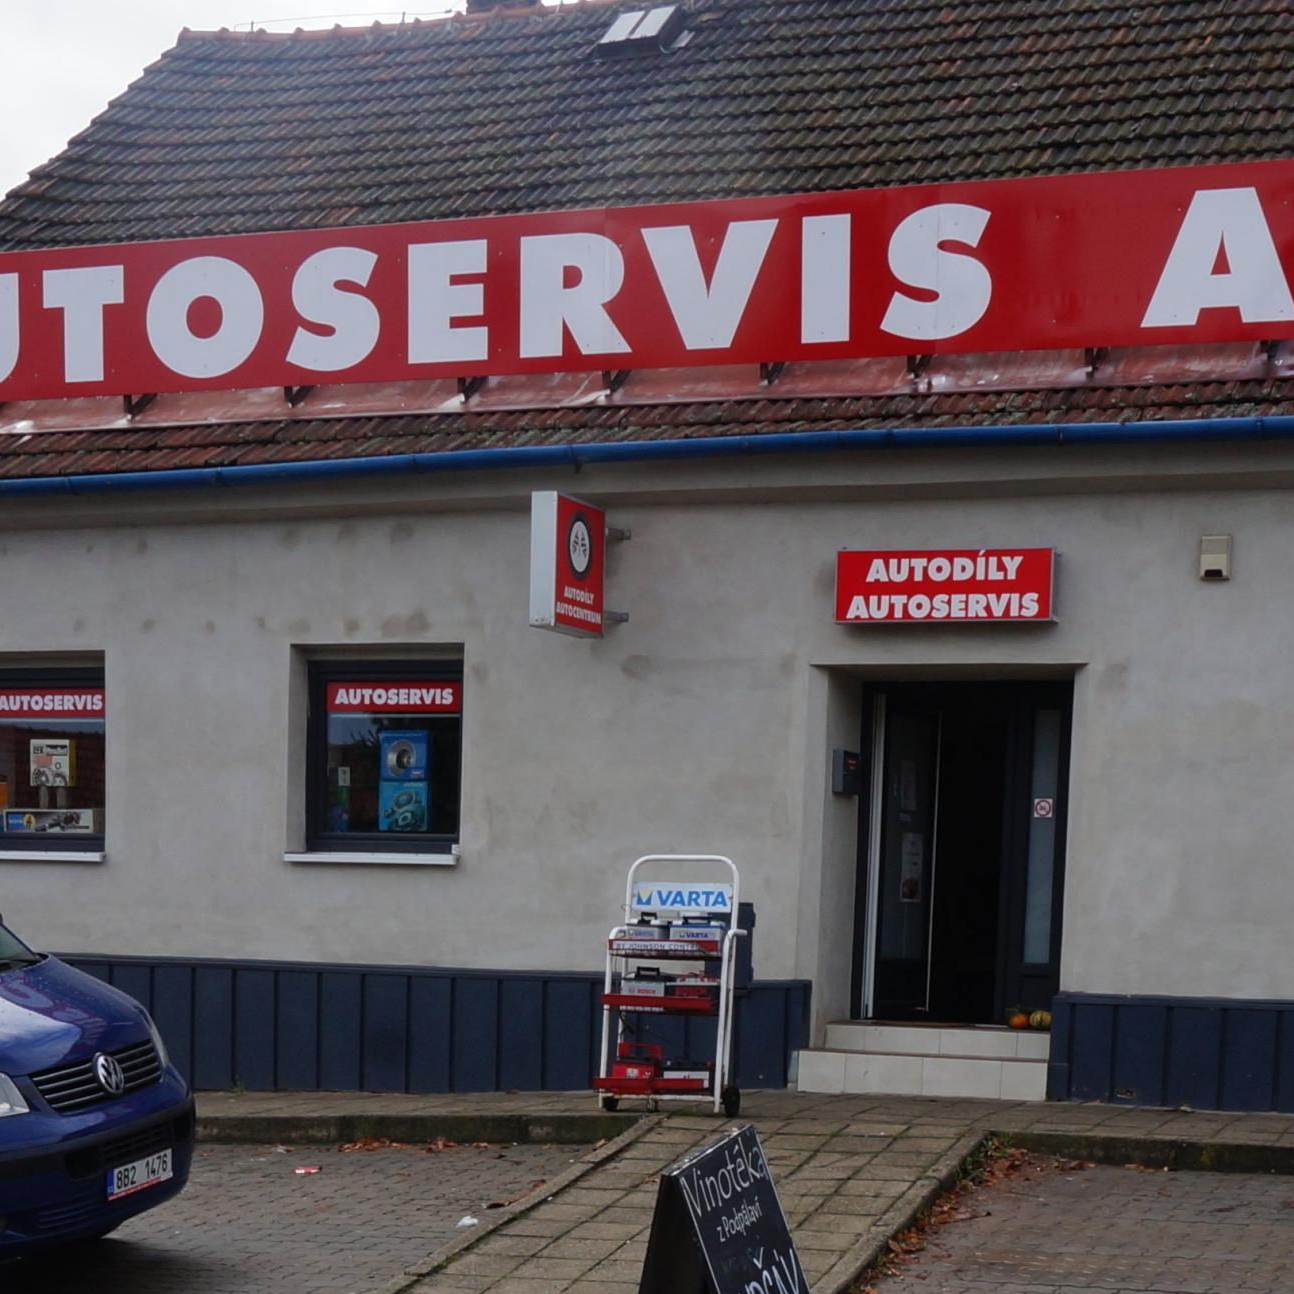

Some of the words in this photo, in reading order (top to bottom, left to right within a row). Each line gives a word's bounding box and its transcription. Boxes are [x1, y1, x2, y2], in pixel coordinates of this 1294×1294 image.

[865, 549, 1024, 583] AUTODÍLY
[556, 601, 602, 625] AUTOCENTRUM
[846, 592, 1039, 619] AUTOSERVIS
[335, 688, 453, 705] AUTOSERVIS
[657, 889, 728, 907] VARTA
[116, 1165, 137, 1190] 8B2
[145, 1153, 168, 1179] 1476
[679, 1136, 769, 1217] Vinotéka
[716, 1225, 726, 1242] z
